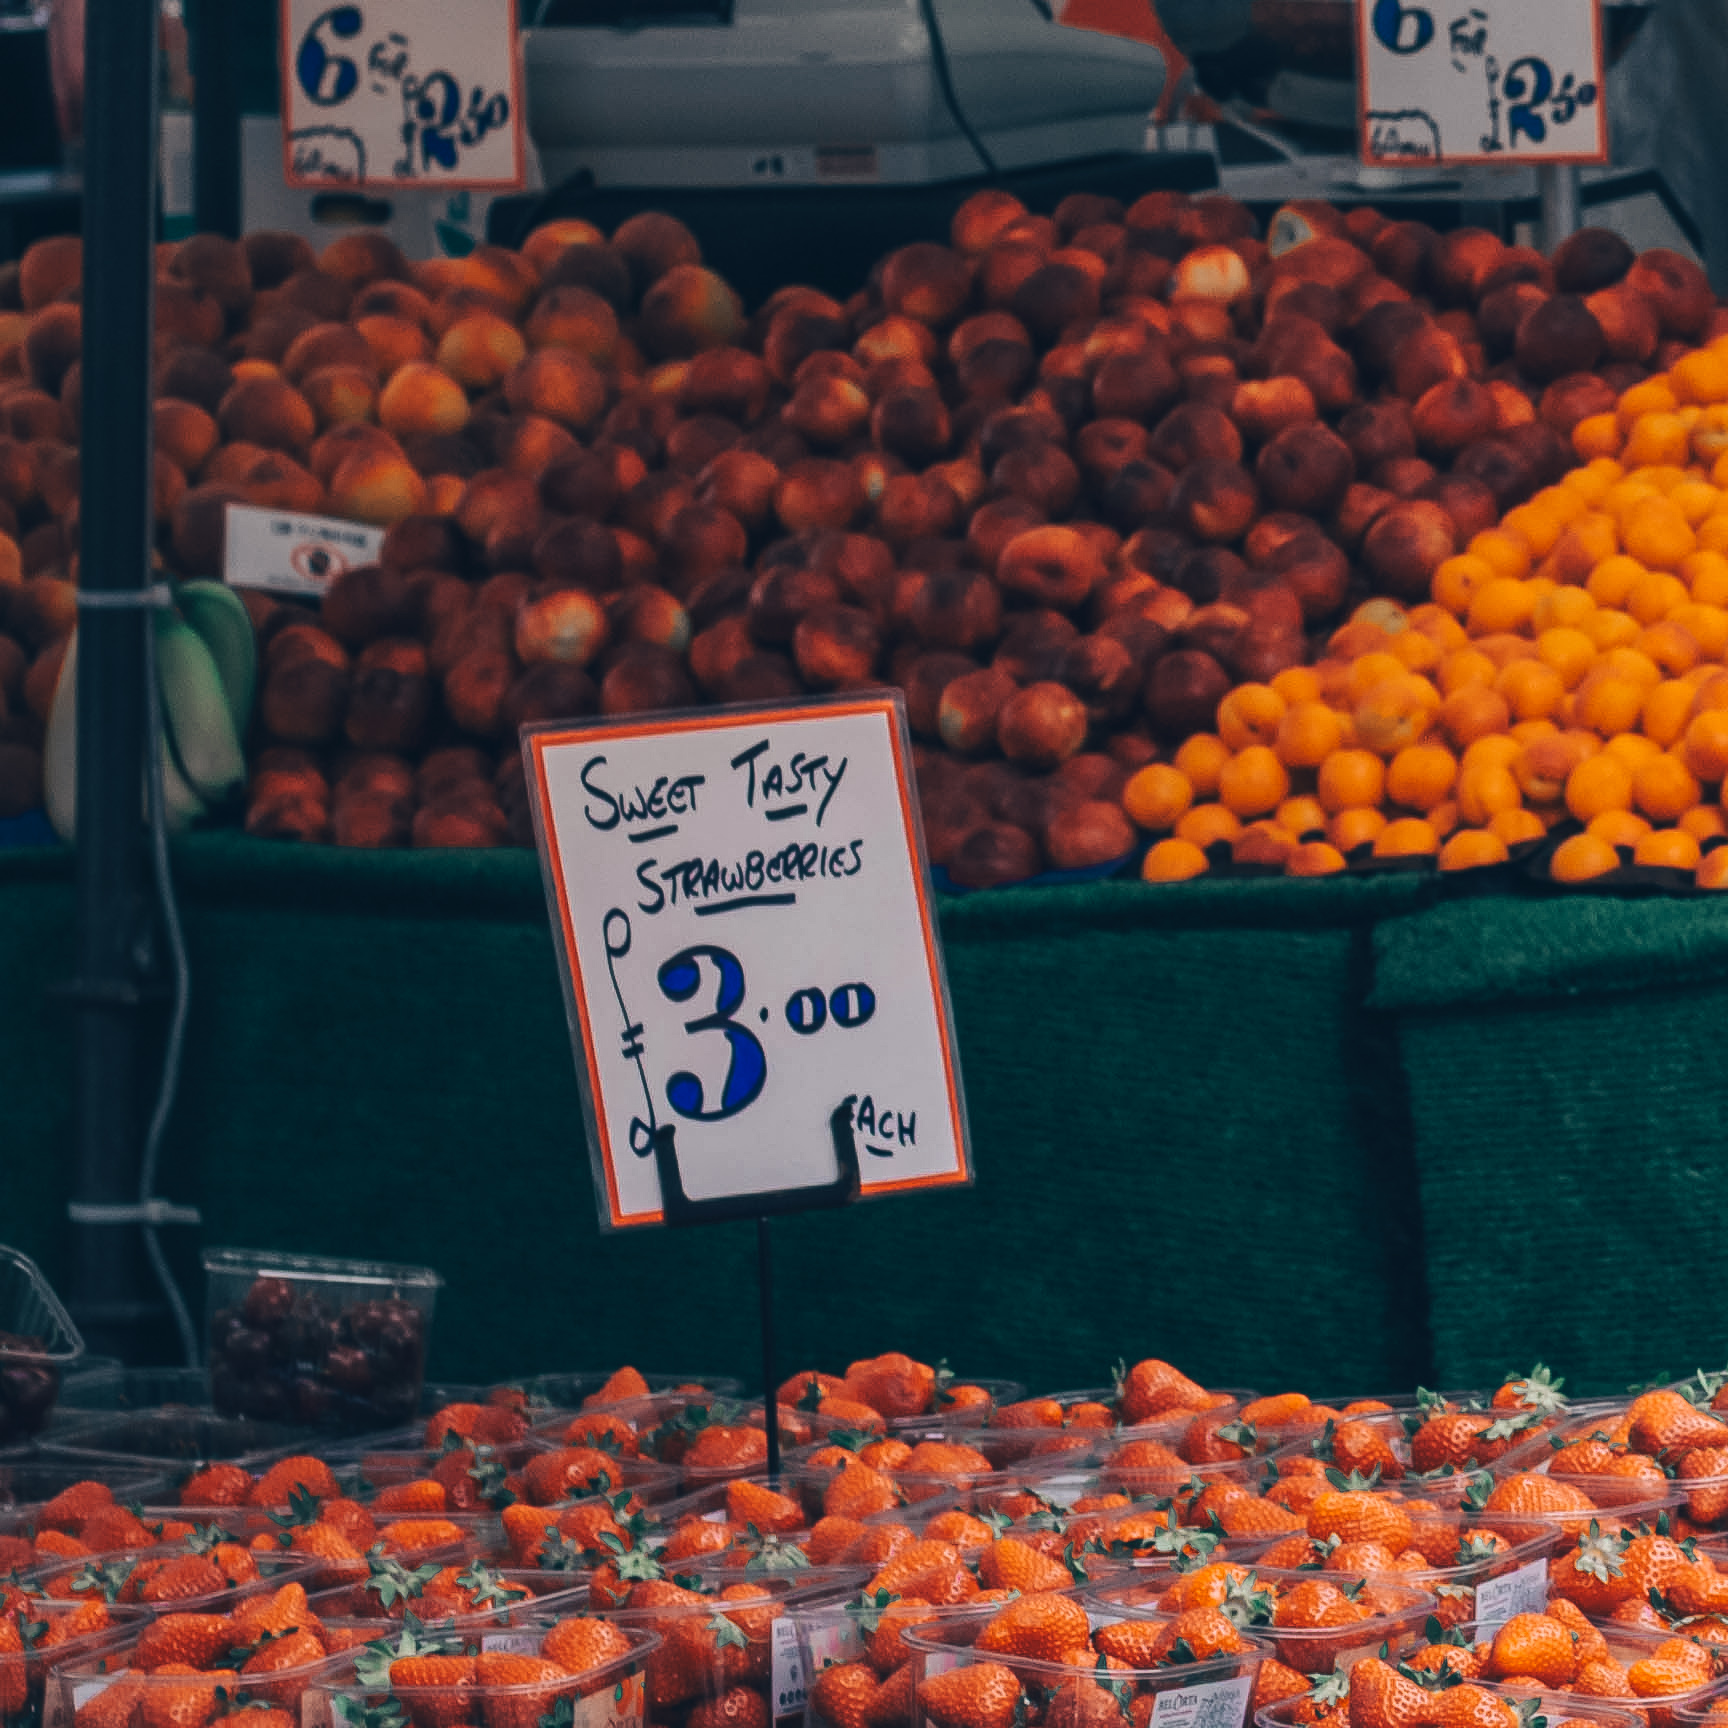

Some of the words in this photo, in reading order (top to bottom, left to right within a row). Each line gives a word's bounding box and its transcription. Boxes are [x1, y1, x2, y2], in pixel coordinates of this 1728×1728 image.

[297, 5, 364, 107] 6
[580, 755, 705, 831] SWEET
[731, 738, 848, 826] TASTY
[637, 839, 863, 915] STRAWBERRIES
